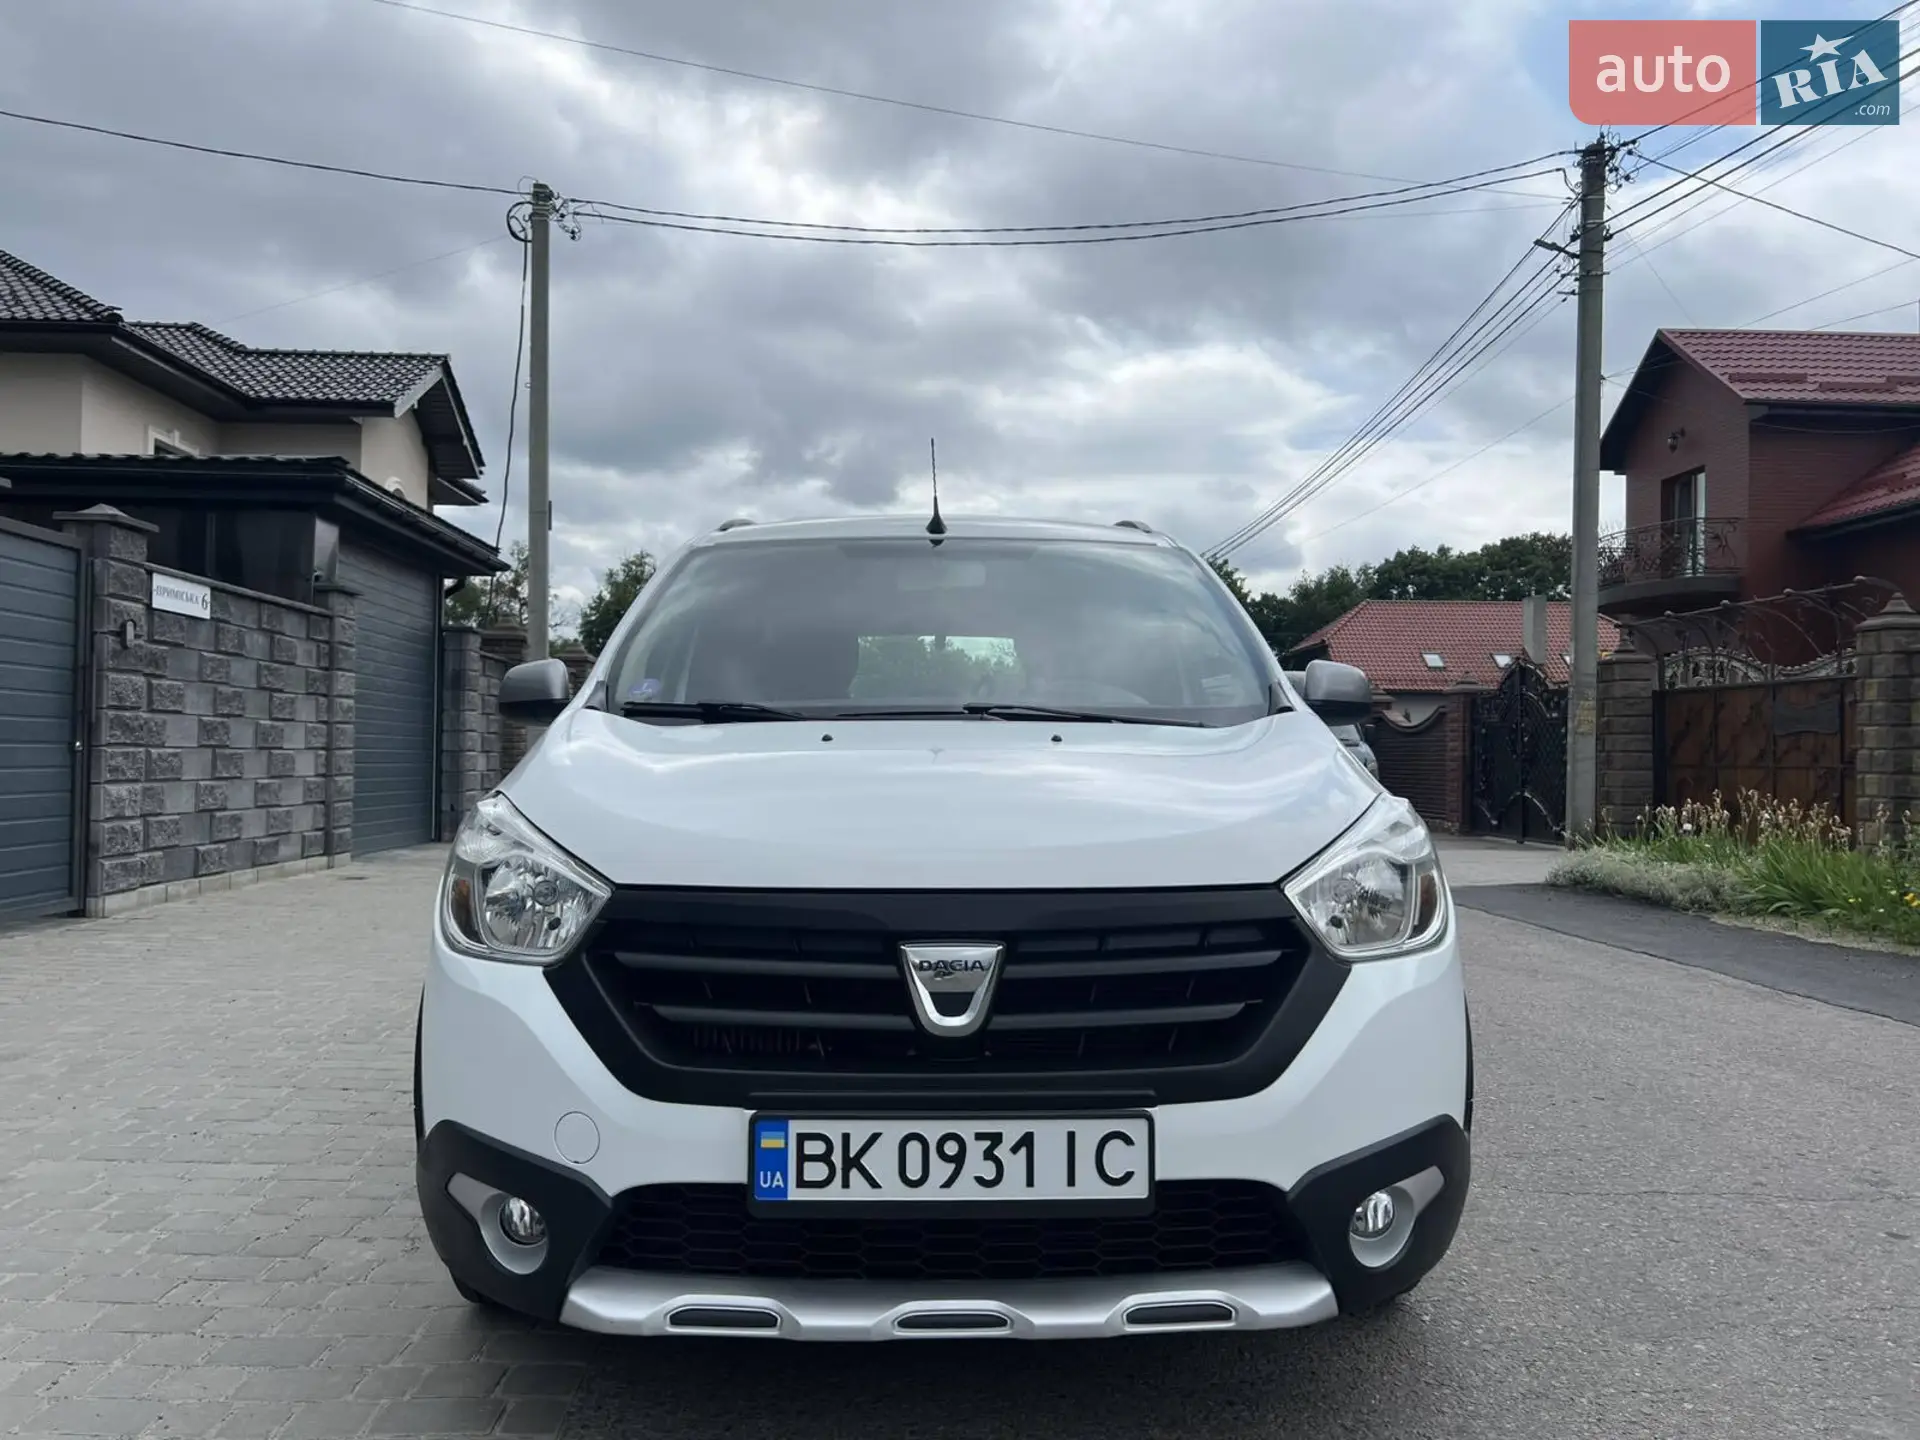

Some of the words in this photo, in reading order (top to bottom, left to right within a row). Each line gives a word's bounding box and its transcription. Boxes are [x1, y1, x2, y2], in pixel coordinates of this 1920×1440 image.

[201, 592, 209, 610] 6
[918, 959, 985, 972] DACIA
[795, 1131, 883, 1189] BK
[898, 1131, 1035, 1189] 0931
[1067, 1130, 1135, 1188] IC
[759, 1171, 784, 1188] UA
